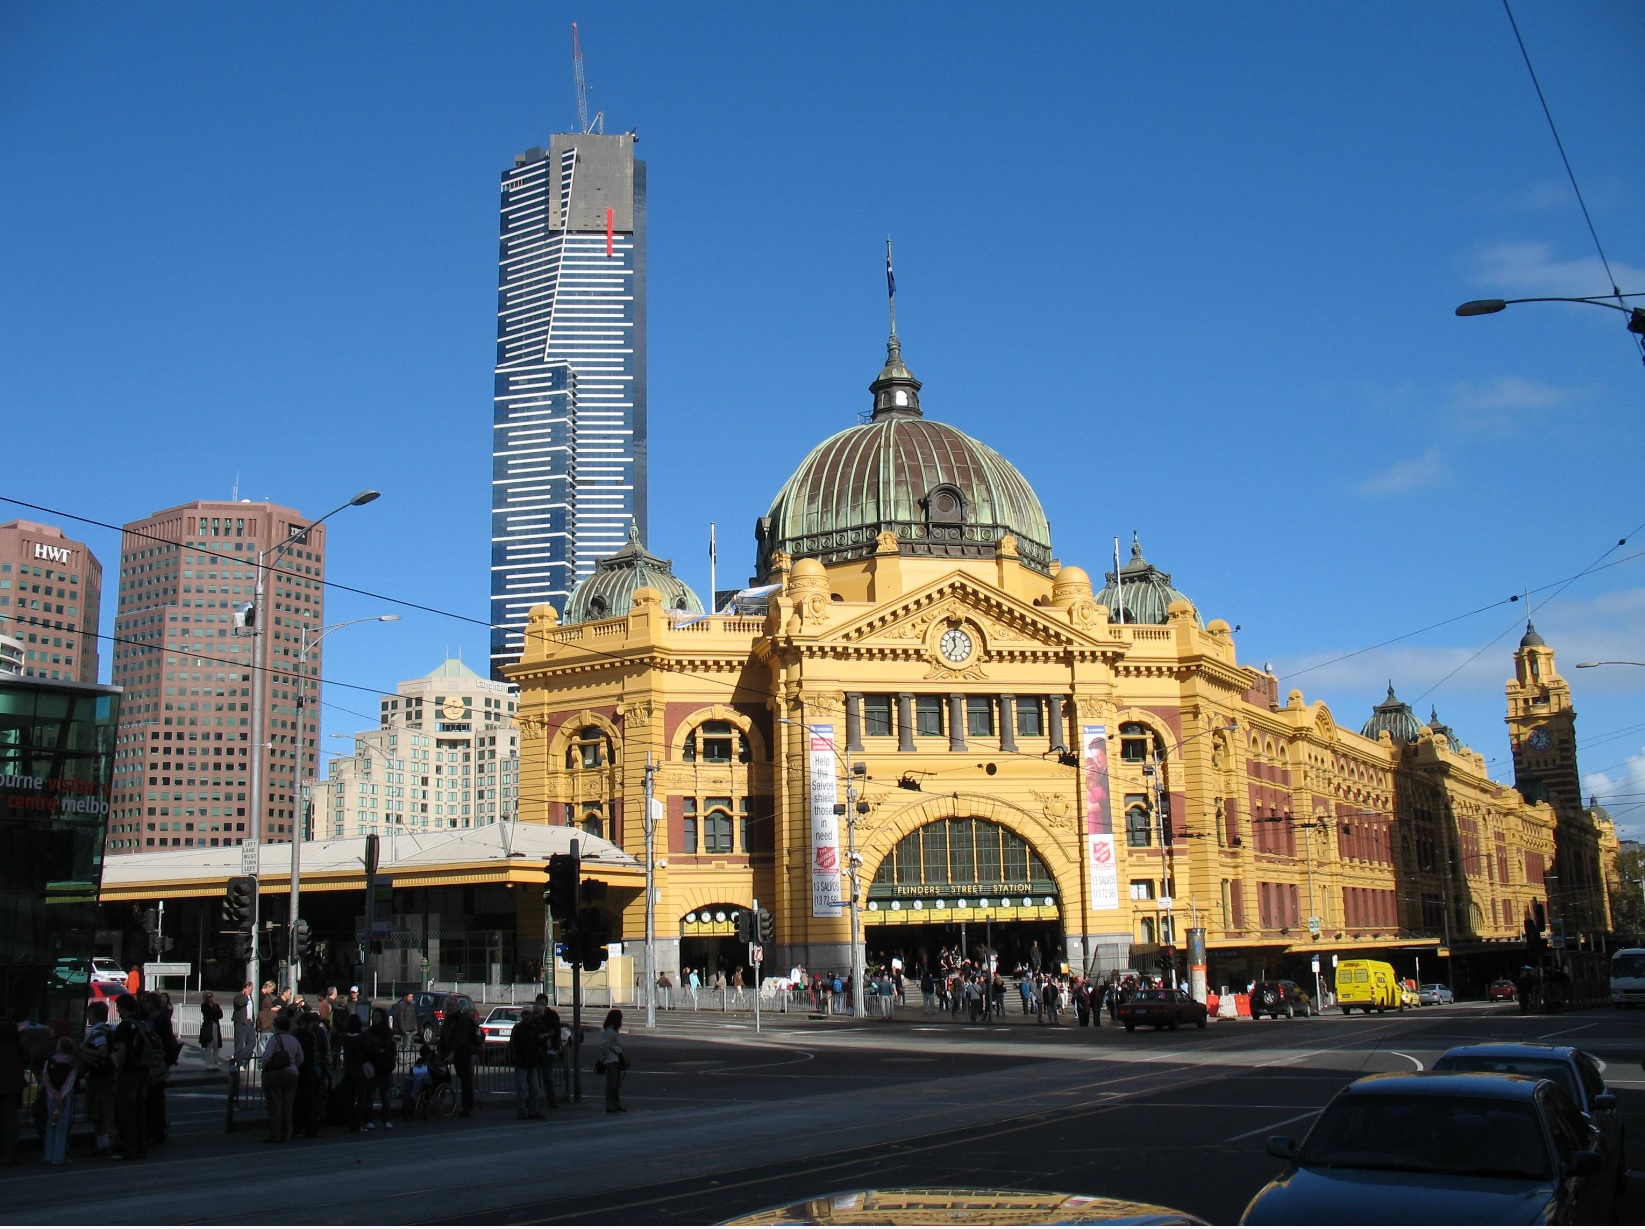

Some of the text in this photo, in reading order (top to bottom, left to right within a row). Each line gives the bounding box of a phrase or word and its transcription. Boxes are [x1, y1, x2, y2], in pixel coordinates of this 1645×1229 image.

[34, 543, 71, 564] HWT
[476, 678, 508, 692] Langham
[814, 755, 830, 768] Help
[817, 768, 829, 779] the
[48, 777, 97, 795] visitor
[811, 780, 835, 791] Salvos
[814, 791, 835, 803] shield
[7, 796, 58, 812] centre
[814, 805, 833, 816] those
[820, 817, 828, 828] in
[815, 830, 833, 841] need
[820, 881, 840, 891] SALVOS
[897, 883, 1032, 894] FLINDERS STREET STATION
